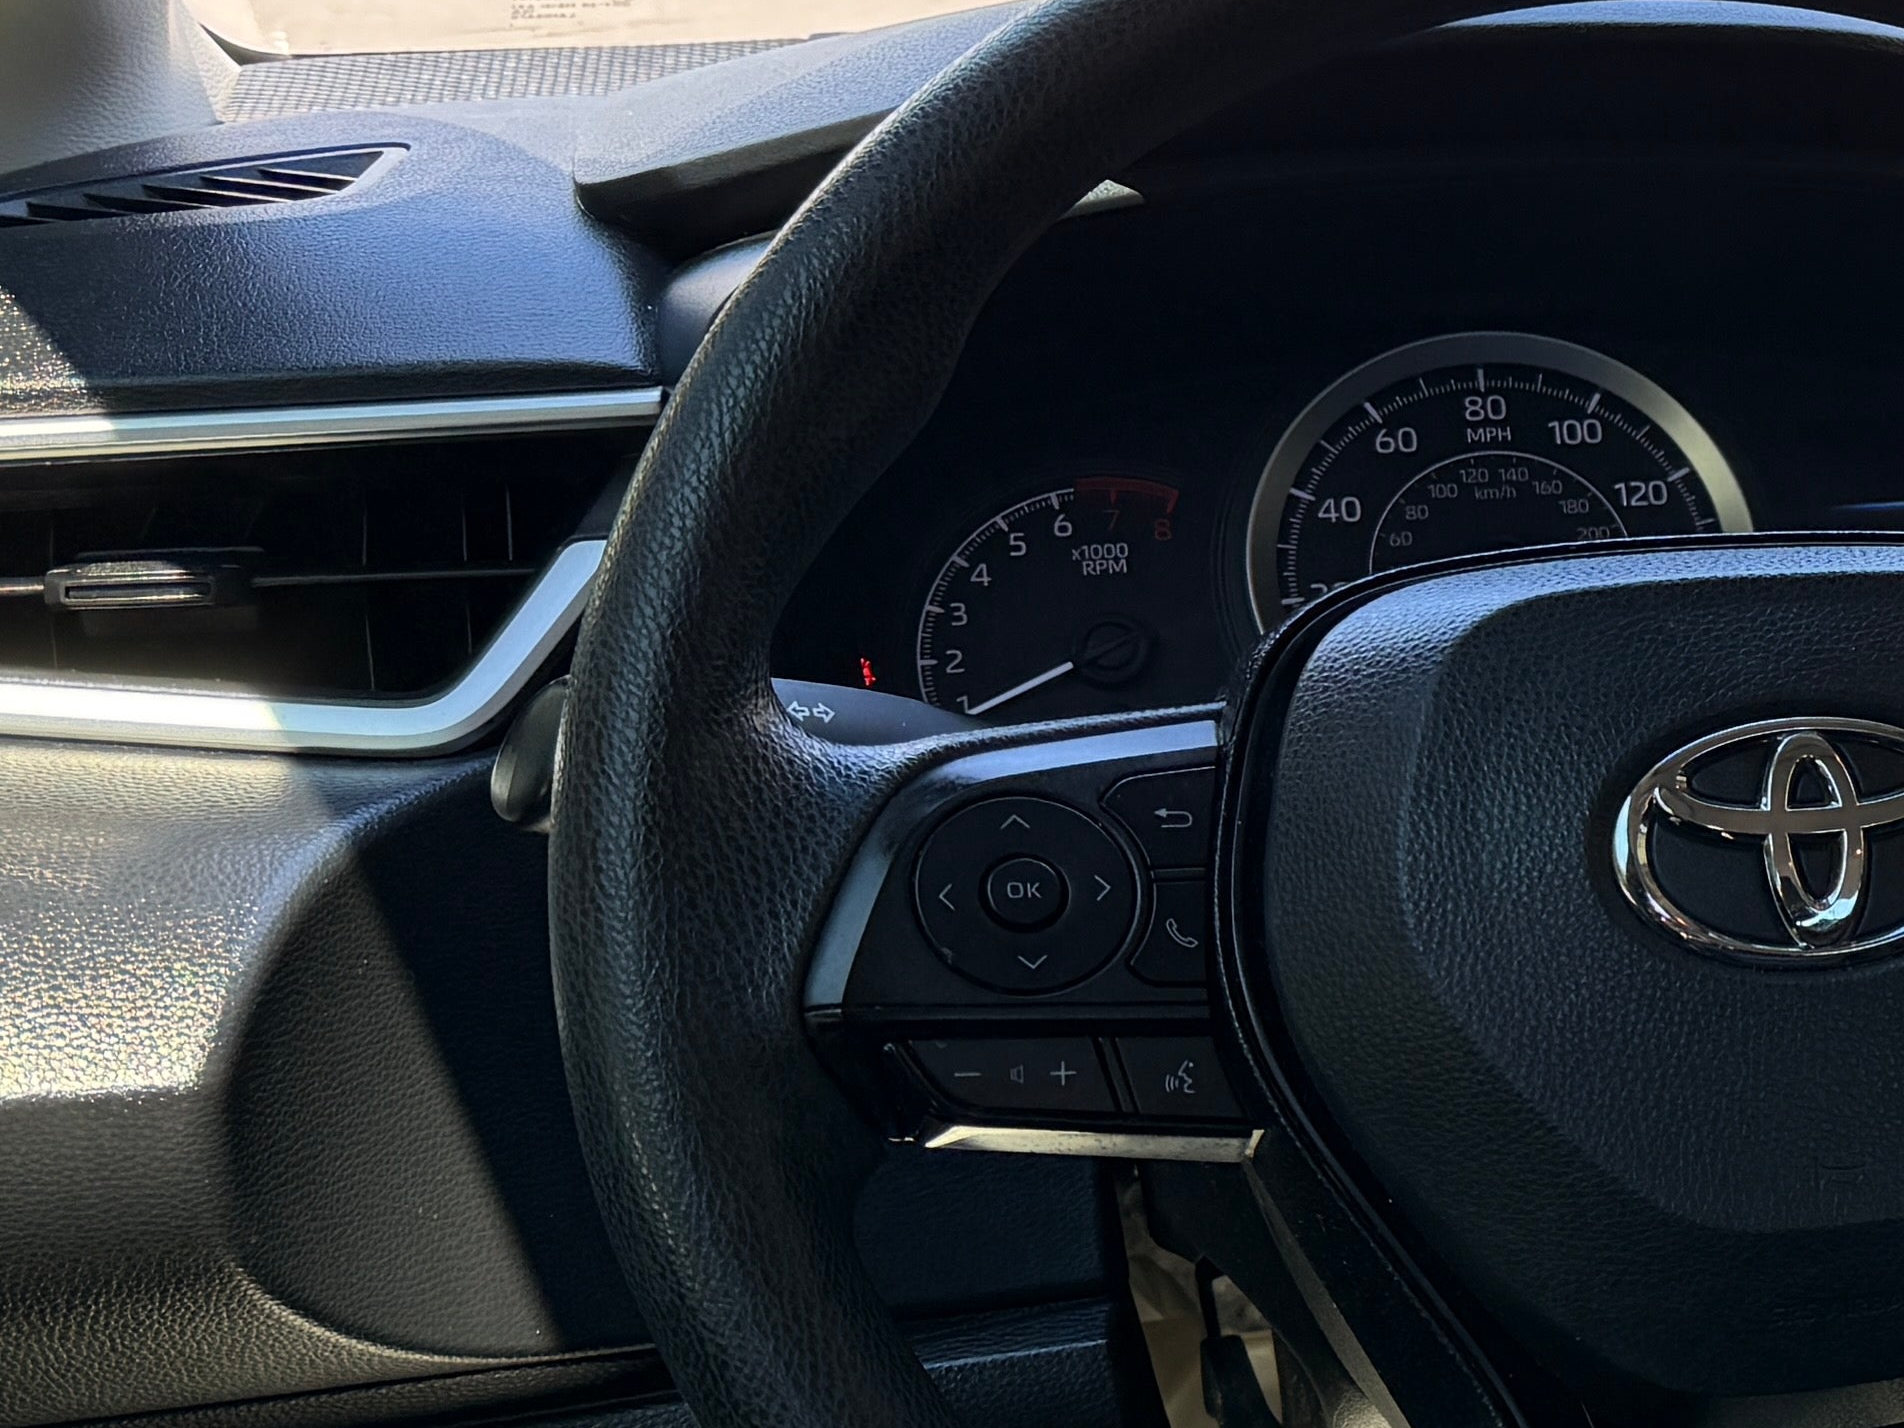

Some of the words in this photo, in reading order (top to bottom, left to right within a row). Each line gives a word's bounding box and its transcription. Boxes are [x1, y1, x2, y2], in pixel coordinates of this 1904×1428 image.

[1463, 396, 1507, 421] 80
[1375, 427, 1418, 453] 60
[1466, 426, 1512, 442] MPH
[1546, 419, 1604, 446] 100
[1459, 468, 1490, 484] 120
[1498, 466, 1530, 483] 140
[1427, 483, 1459, 500] 100
[1474, 483, 1516, 502] km/h
[1532, 479, 1563, 496] 160
[1614, 480, 1668, 506] 120
[1317, 496, 1362, 523] 40
[1405, 504, 1429, 521] 80
[1558, 497, 1590, 515] 180
[1053, 514, 1073, 537] 6
[1105, 509, 1120, 531] 7
[1153, 519, 1173, 541] 8
[1008, 532, 1028, 557] 5
[1389, 530, 1413, 548] 60
[1071, 542, 1129, 563] x1000
[969, 563, 991, 588] 4
[1082, 557, 1128, 576] RPM
[949, 603, 968, 626] 3
[944, 650, 964, 673] 2
[1006, 881, 1043, 900] OK
